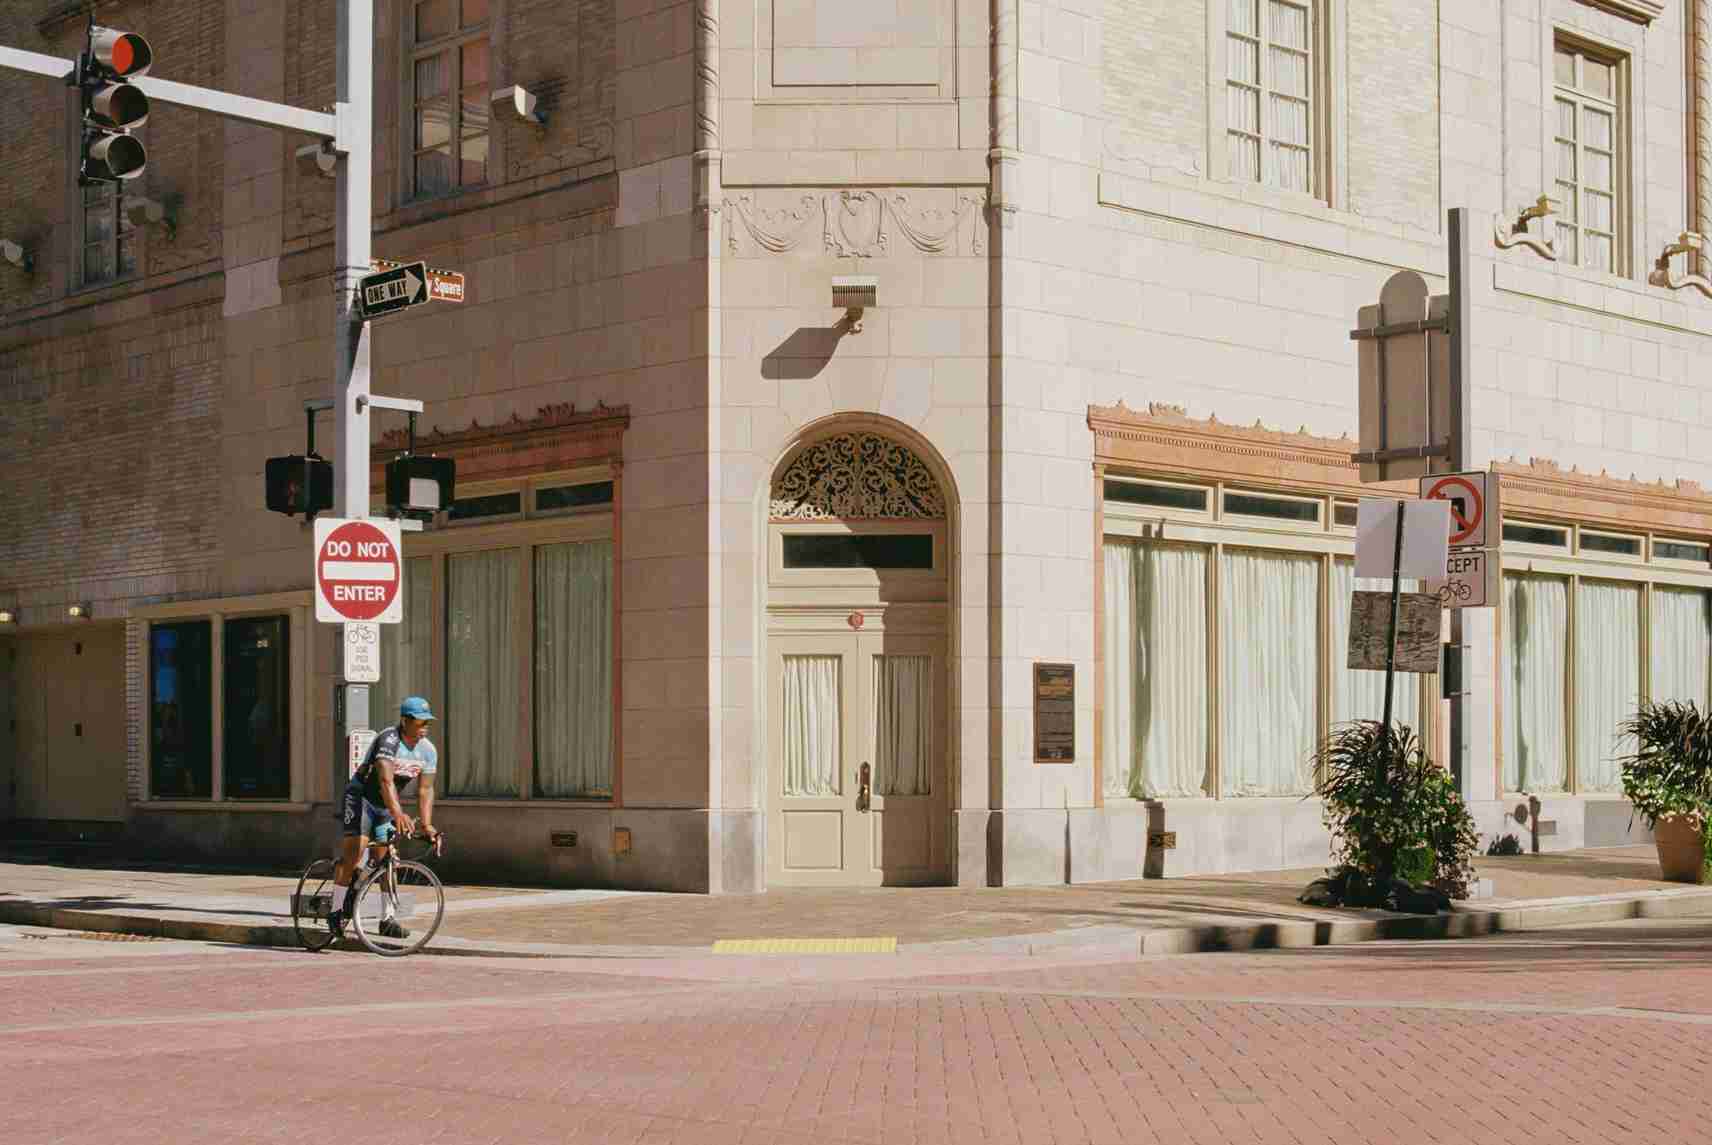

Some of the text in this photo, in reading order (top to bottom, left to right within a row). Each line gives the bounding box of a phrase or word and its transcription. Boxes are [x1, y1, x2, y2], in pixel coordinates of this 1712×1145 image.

[366, 279, 407, 304] ONE WAY
[432, 277, 462, 297] Square
[327, 541, 389, 558] DO NOT
[1446, 557, 1480, 573] CEPT
[334, 585, 385, 601] ENTER
